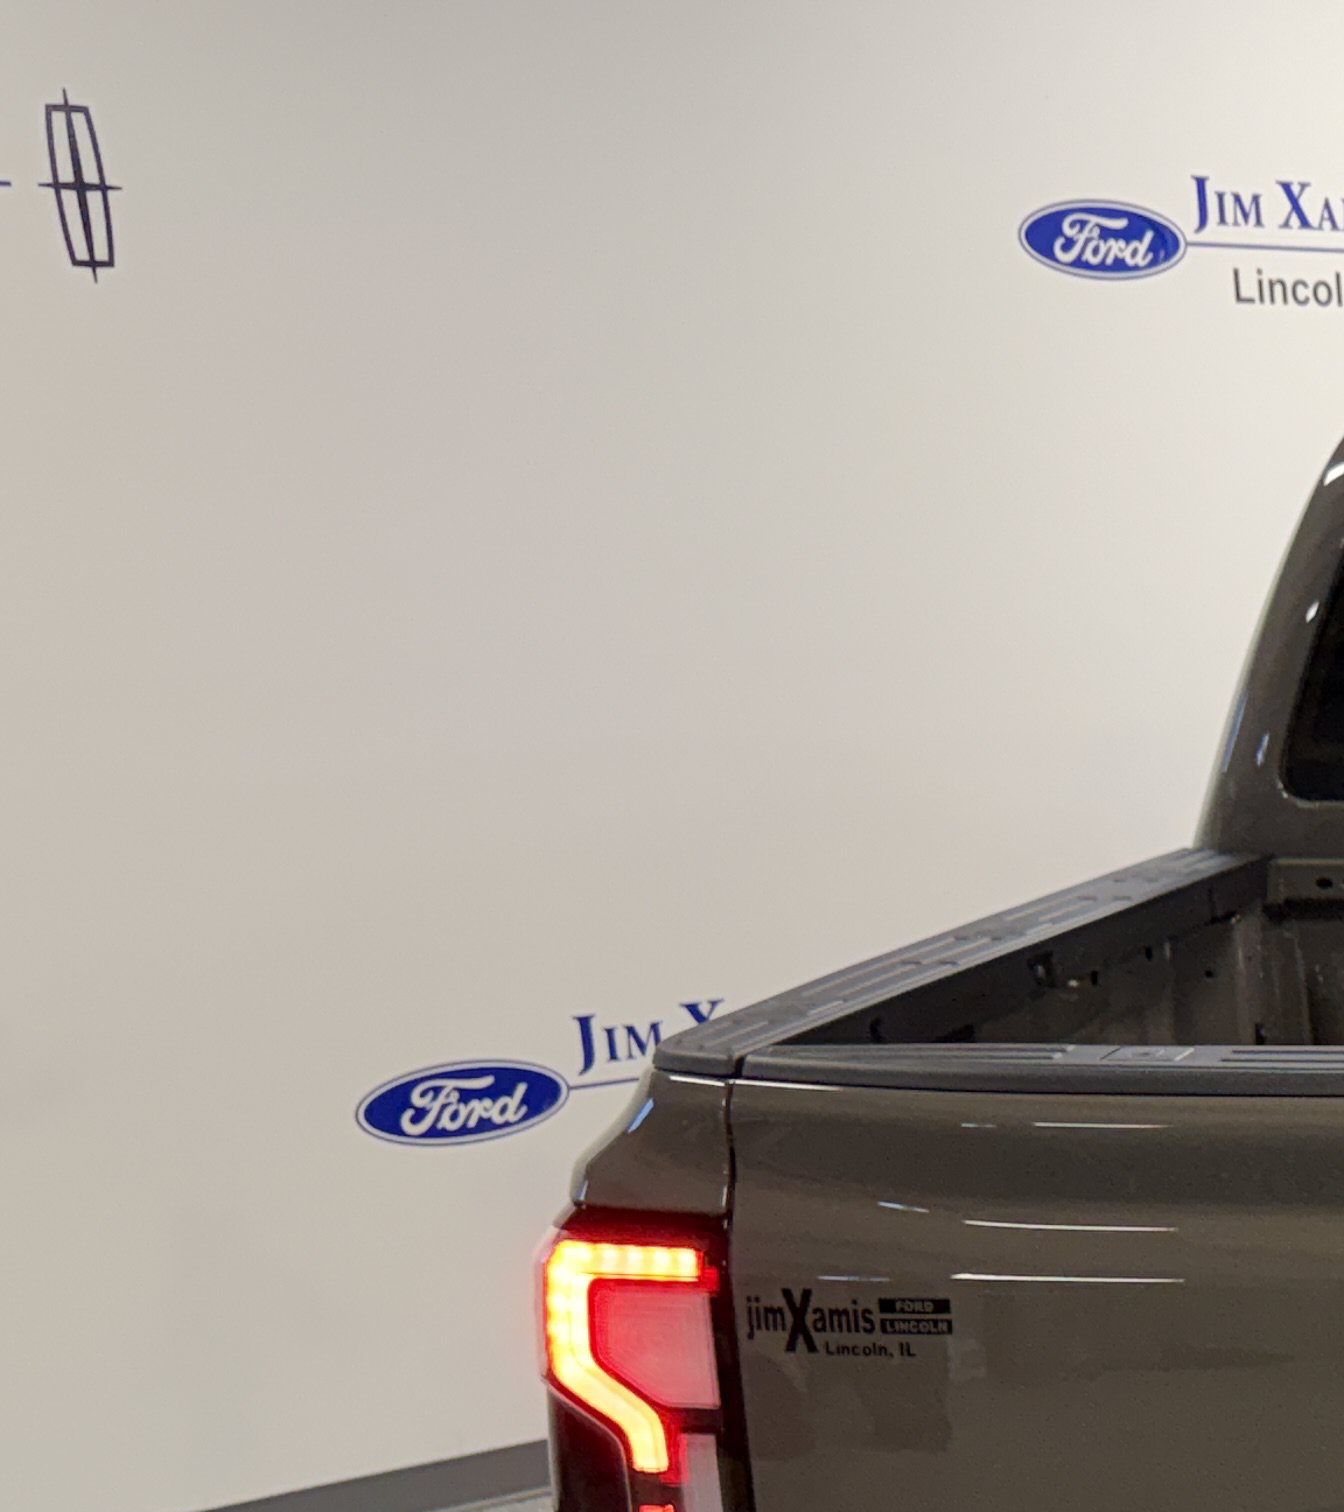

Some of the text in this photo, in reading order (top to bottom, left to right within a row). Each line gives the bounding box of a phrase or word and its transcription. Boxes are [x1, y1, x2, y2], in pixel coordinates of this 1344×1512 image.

[1190, 174, 1265, 235] JIM
[1052, 211, 1155, 267] Ford
[401, 1074, 529, 1136] Ford
[825, 1341, 917, 1358] Lincoln, IL
[884, 1318, 949, 1333] LINCOLN
